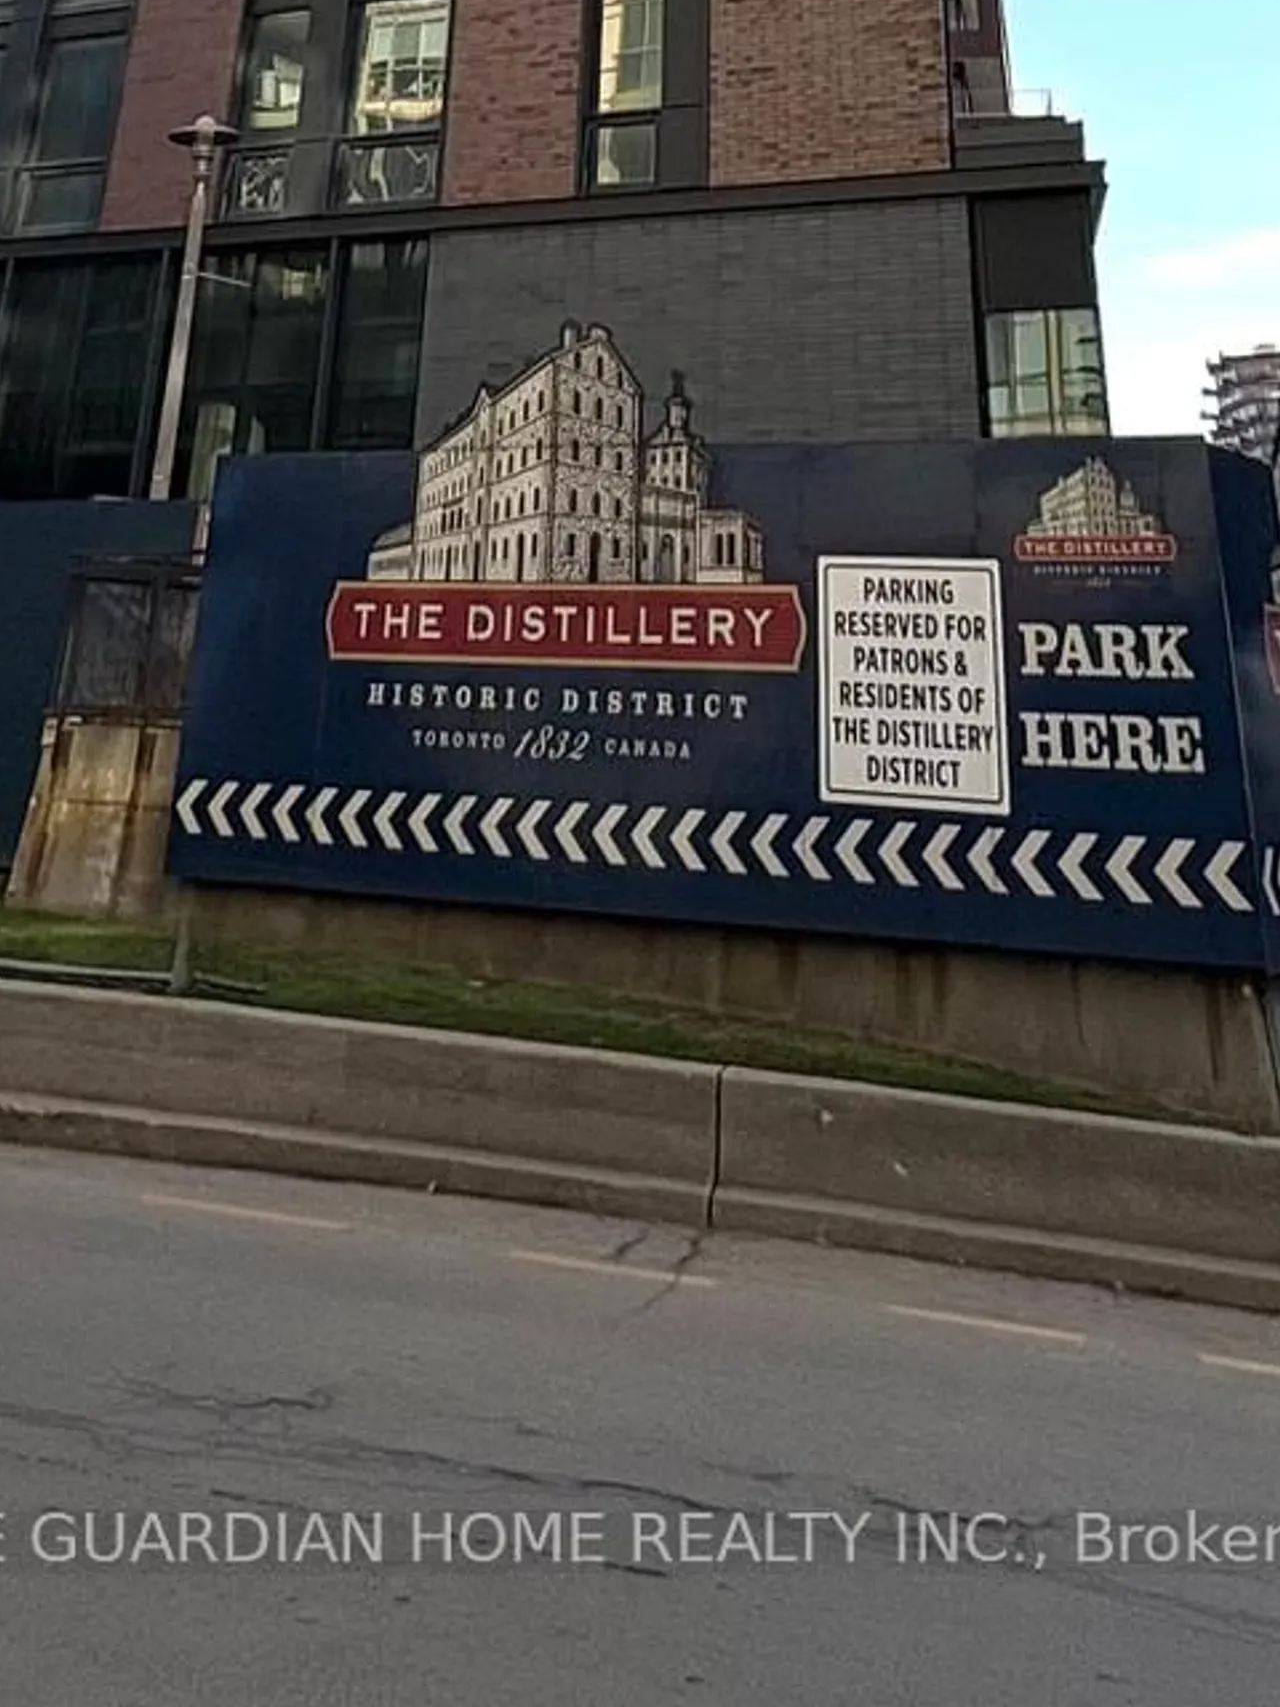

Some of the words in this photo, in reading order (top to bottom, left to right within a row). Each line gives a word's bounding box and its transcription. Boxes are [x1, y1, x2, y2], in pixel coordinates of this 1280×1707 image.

[1024, 541, 1059, 555] THE
[1063, 541, 1167, 555] DISTILLERY
[862, 576, 955, 606] PARKING
[354, 603, 444, 641] THE
[467, 605, 774, 648] DISTILLERY
[833, 610, 938, 640] RESERVED
[945, 614, 987, 643] FOR
[852, 646, 948, 677] PATRONS
[953, 649, 969, 677] &
[1018, 620, 1195, 681] PARK
[366, 682, 541, 712] HISTORIC
[562, 688, 749, 720] DISTRICT
[839, 681, 951, 714] RESIDENTS
[957, 685, 987, 715] OF
[412, 729, 506, 750] TORONTO
[513, 725, 592, 761] 1832
[604, 737, 691, 759] CANADA
[832, 717, 871, 746] THE
[876, 719, 995, 753] DISTILLERY
[1019, 710, 1207, 775] HERE
[865, 755, 962, 788] DISTRICT
